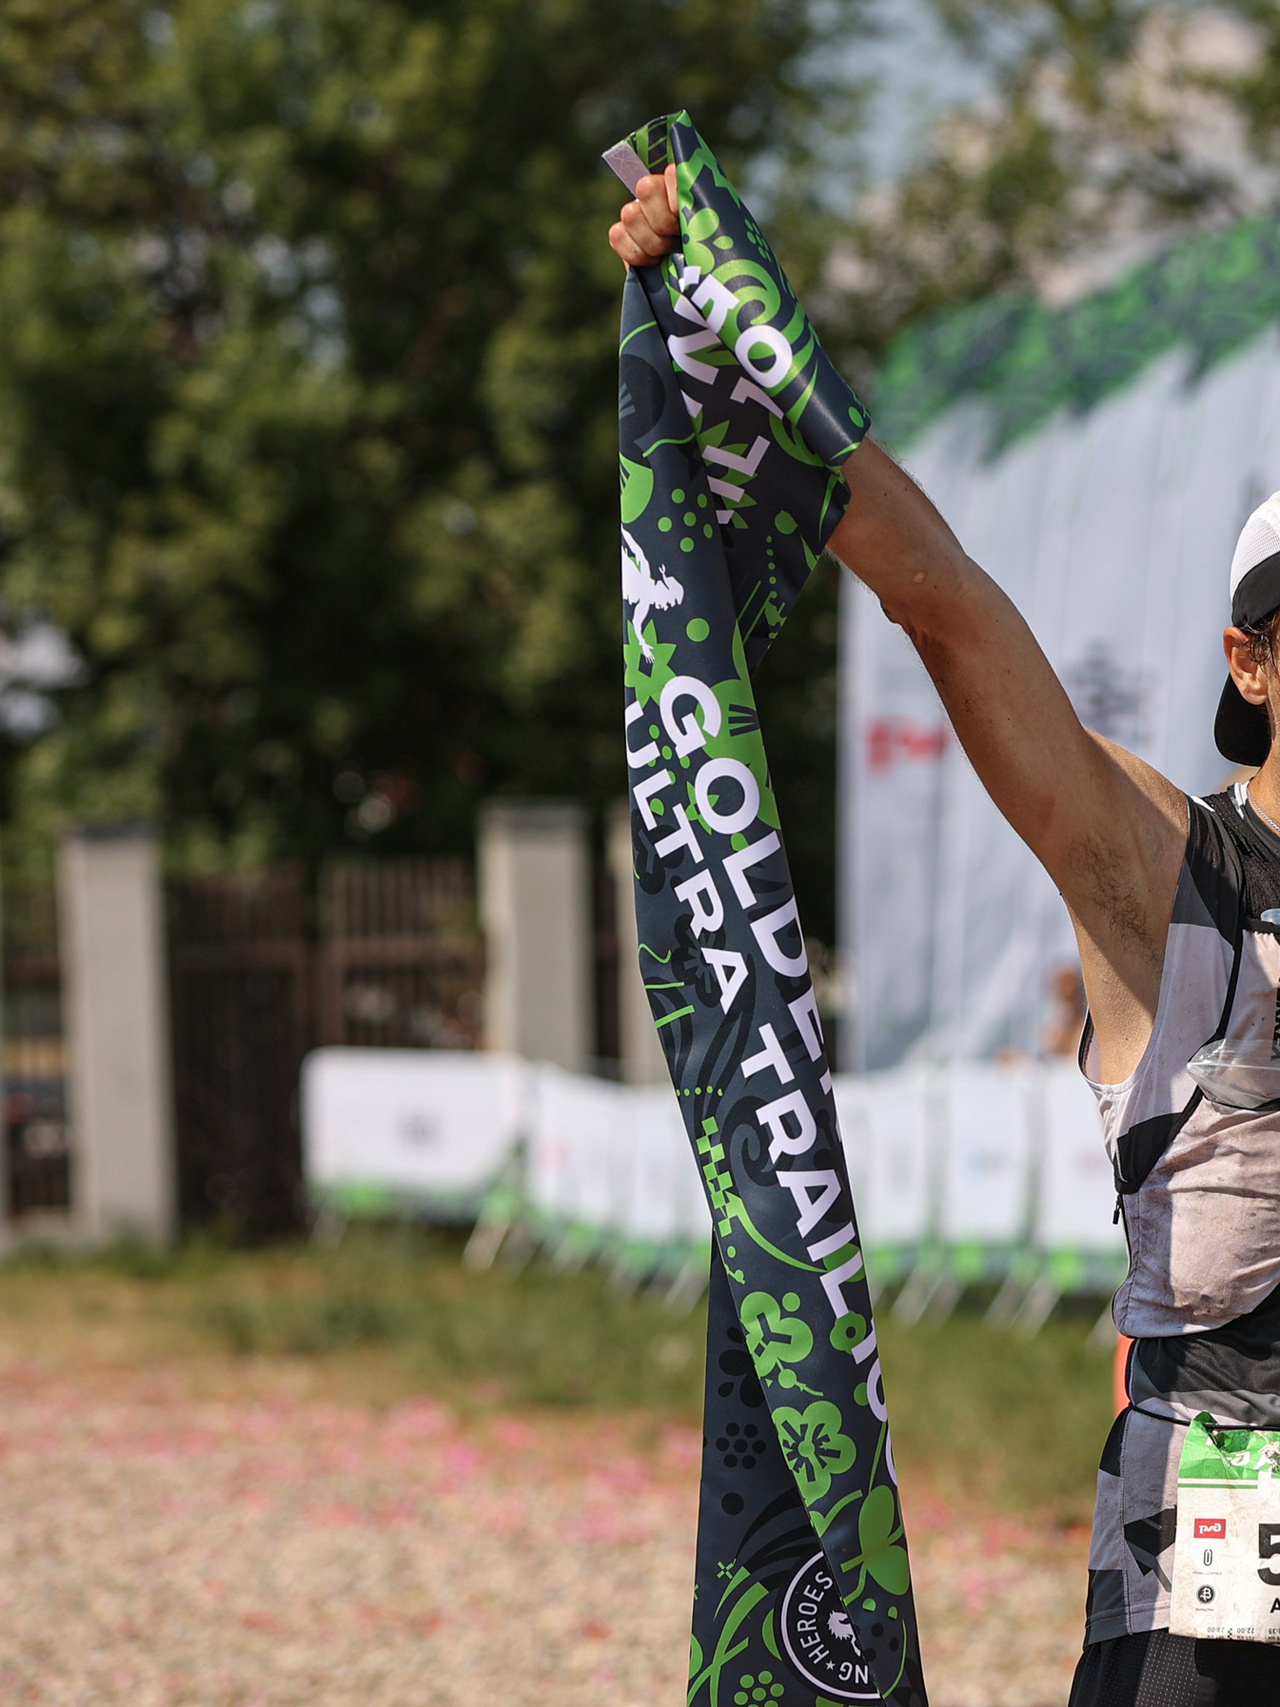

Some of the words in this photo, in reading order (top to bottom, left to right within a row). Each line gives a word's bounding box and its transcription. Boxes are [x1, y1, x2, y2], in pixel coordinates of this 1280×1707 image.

[625, 700, 749, 1015] ULTRA
[741, 1022, 864, 1319] TRAIL
[659, 674, 842, 1142] GOLDE
[797, 1571, 833, 1664] HEROES
